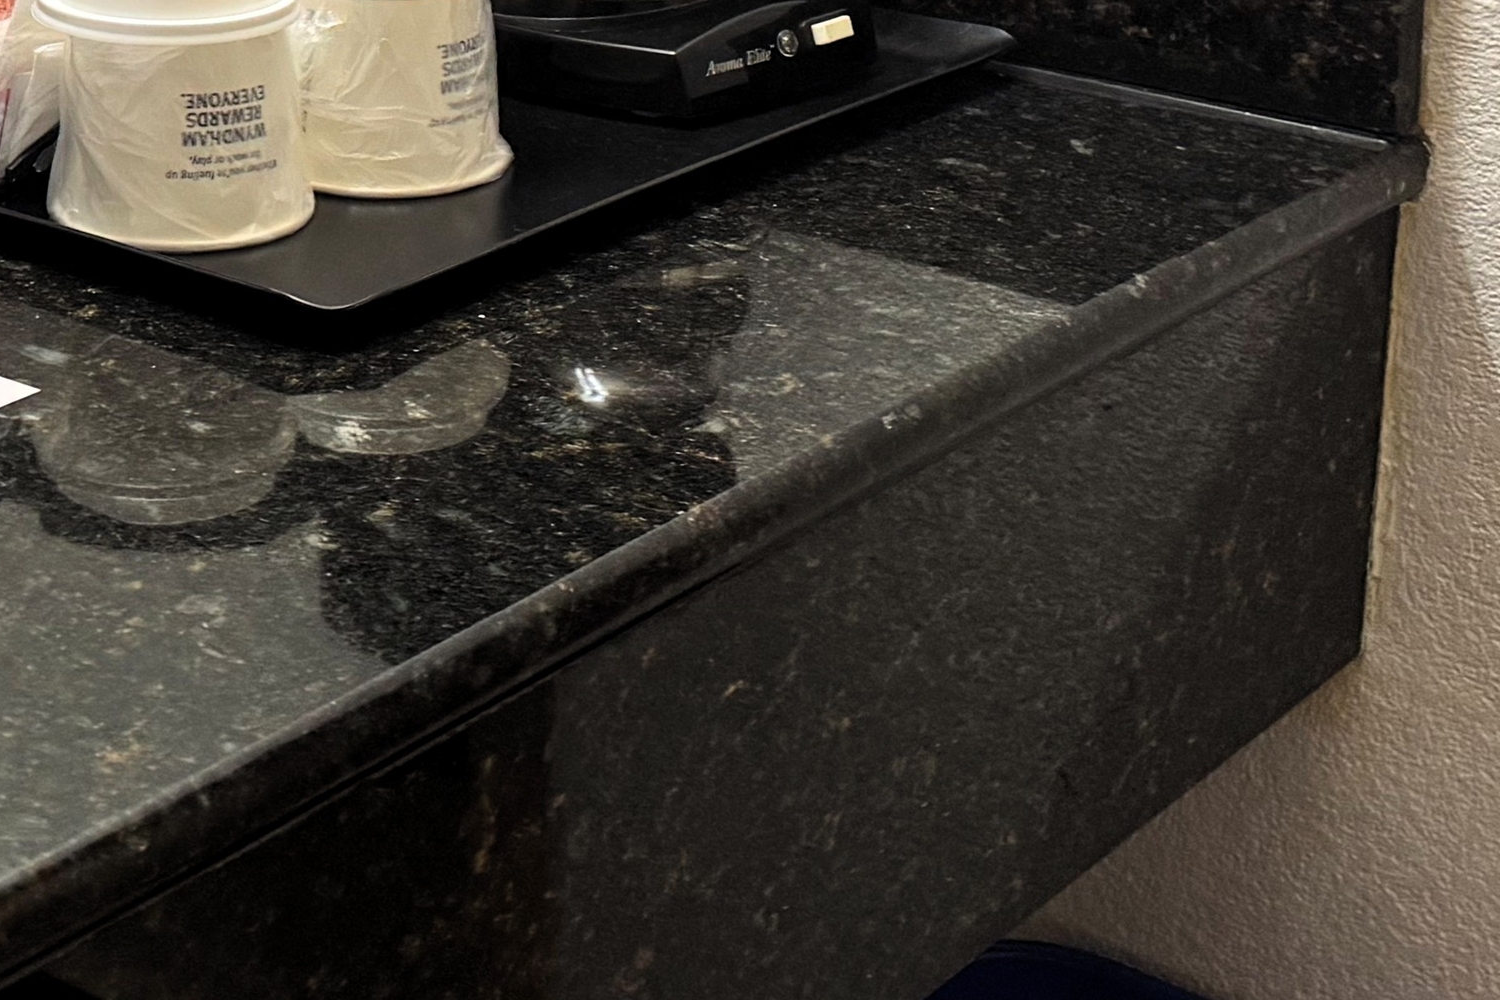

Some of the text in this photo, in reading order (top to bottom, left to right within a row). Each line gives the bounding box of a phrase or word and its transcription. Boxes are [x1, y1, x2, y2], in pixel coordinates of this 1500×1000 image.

[705, 57, 744, 77] Aroma
[180, 84, 265, 109] EVERYONE.
[185, 104, 263, 128] REWARDS
[181, 122, 267, 147] WYNDHAM
[165, 170, 178, 180] up
[180, 169, 215, 180] fueling
